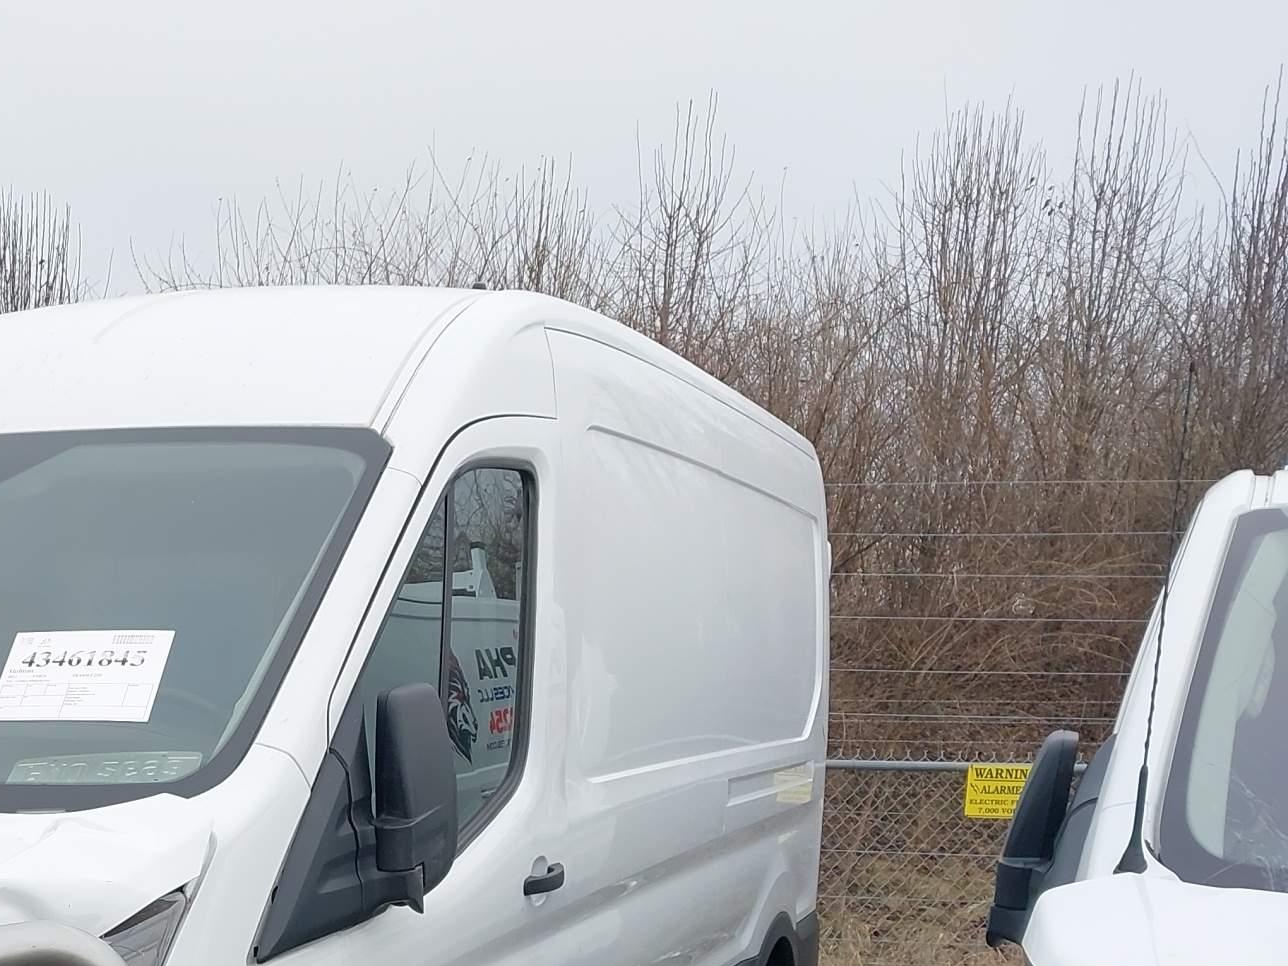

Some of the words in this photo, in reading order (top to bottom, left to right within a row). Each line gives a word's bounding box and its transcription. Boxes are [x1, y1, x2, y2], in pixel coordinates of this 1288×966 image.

[21, 650, 148, 668] 43461845
[974, 768, 1029, 779] WARNIN
[980, 785, 1023, 795] ALARME
[969, 798, 1009, 806] ELECTRIC
